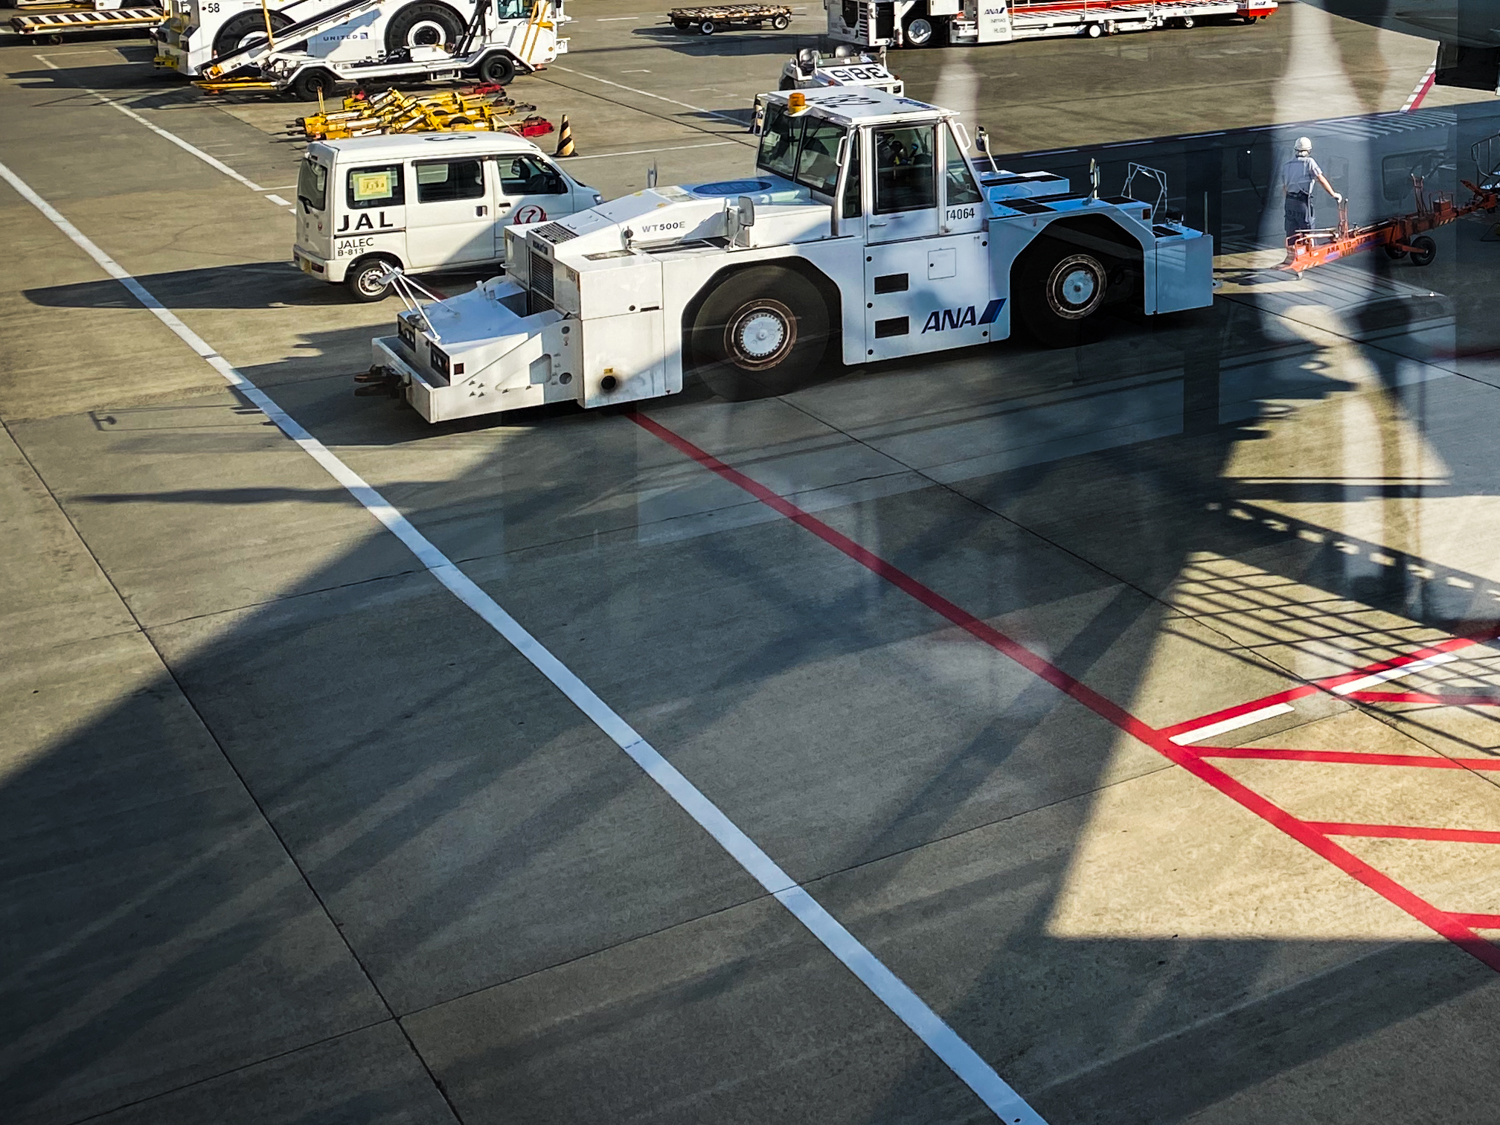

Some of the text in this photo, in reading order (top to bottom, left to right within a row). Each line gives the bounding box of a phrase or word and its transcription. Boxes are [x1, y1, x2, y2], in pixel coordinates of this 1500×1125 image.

[207, 2, 220, 14] 58
[322, 34, 358, 42] UNITED
[337, 211, 394, 232] JAL
[641, 220, 686, 233] WT500E
[337, 237, 374, 250] JALEC
[337, 247, 365, 257] B-813
[921, 305, 978, 335] ANA
